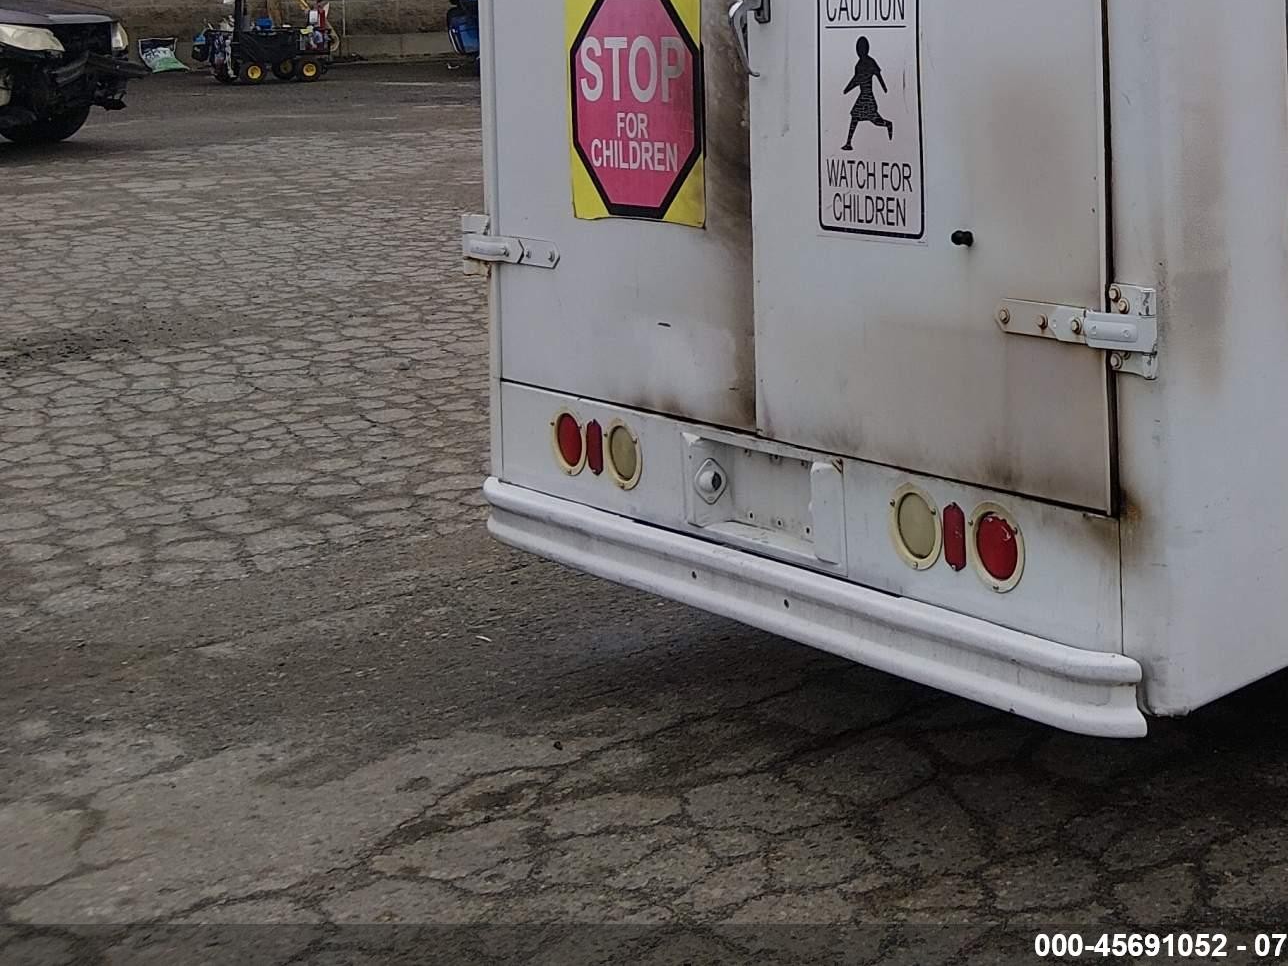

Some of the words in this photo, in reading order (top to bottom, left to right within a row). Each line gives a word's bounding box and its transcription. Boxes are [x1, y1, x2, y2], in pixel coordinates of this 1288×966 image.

[580, 35, 685, 103] STOP
[616, 112, 649, 139] FOR
[591, 138, 678, 173] CHILDREN
[826, 159, 877, 192] WATCH
[882, 162, 913, 193] FOR
[832, 192, 907, 228] CHILDREN
